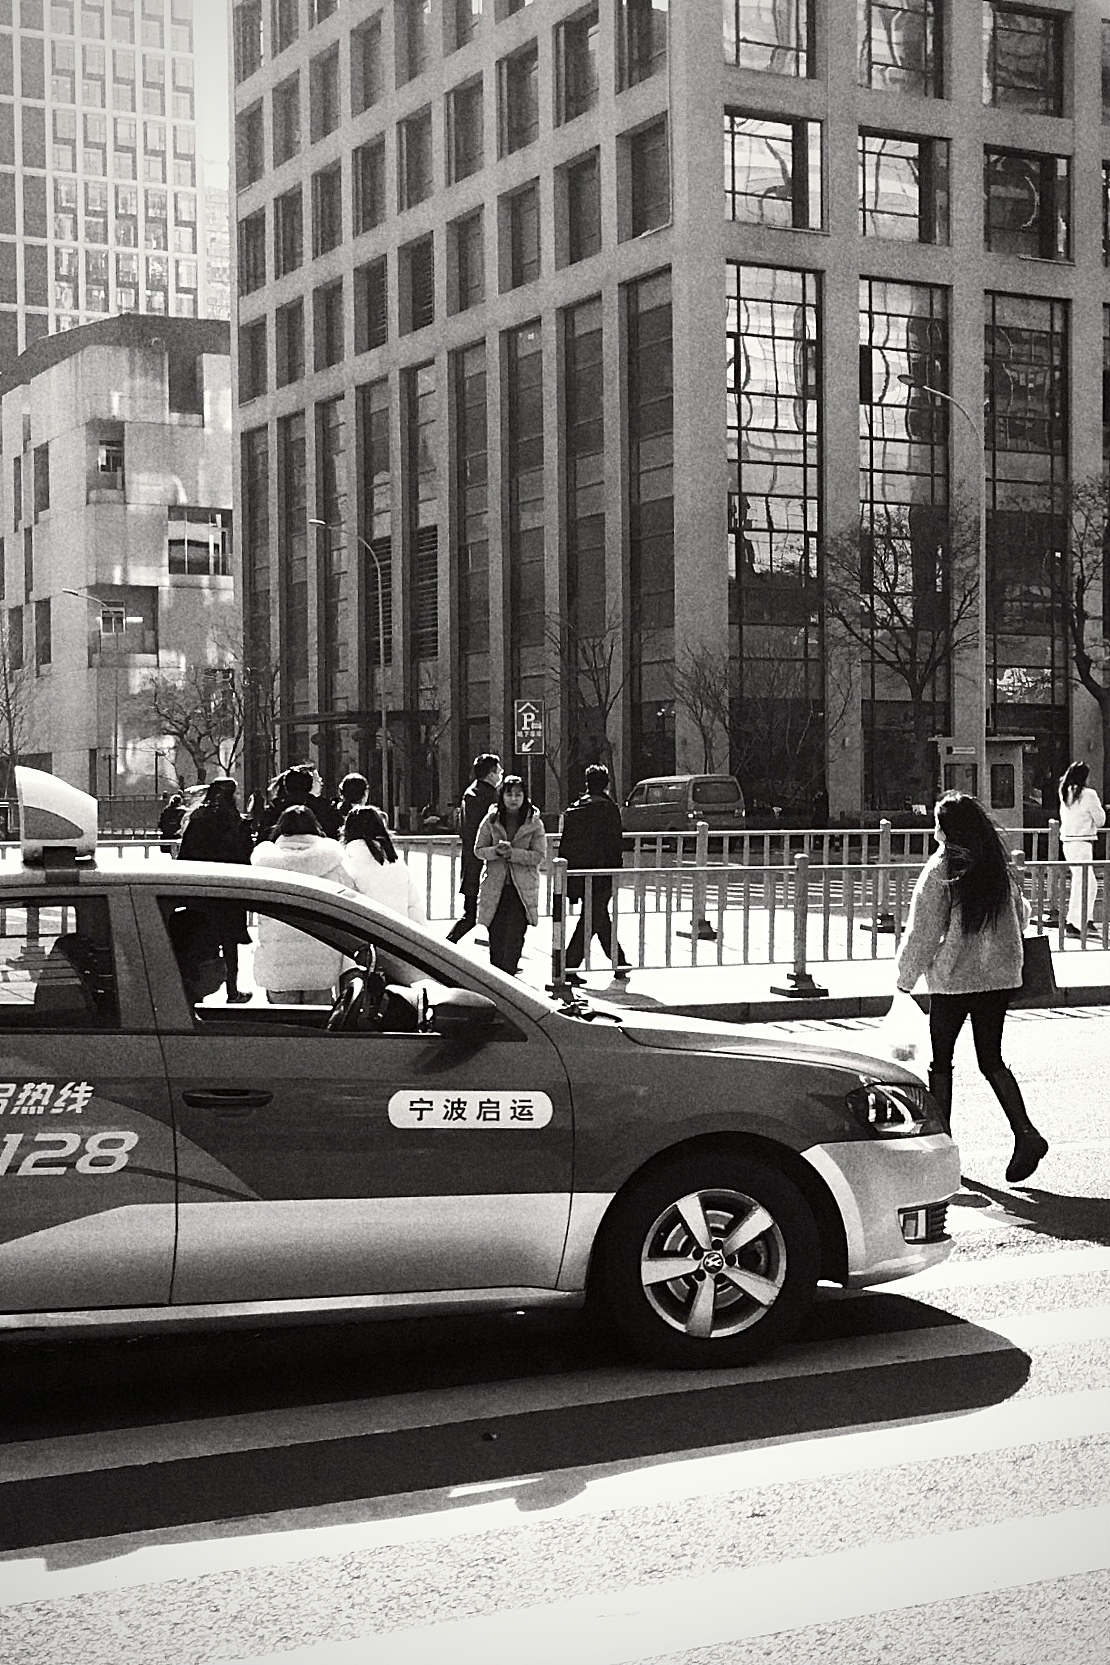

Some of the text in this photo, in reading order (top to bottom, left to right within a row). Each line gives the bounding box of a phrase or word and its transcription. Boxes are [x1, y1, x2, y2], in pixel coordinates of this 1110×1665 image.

[521, 712, 536, 731] P
[409, 1097, 534, 1121] 宁波启运
[0, 1130, 140, 1176] 128
